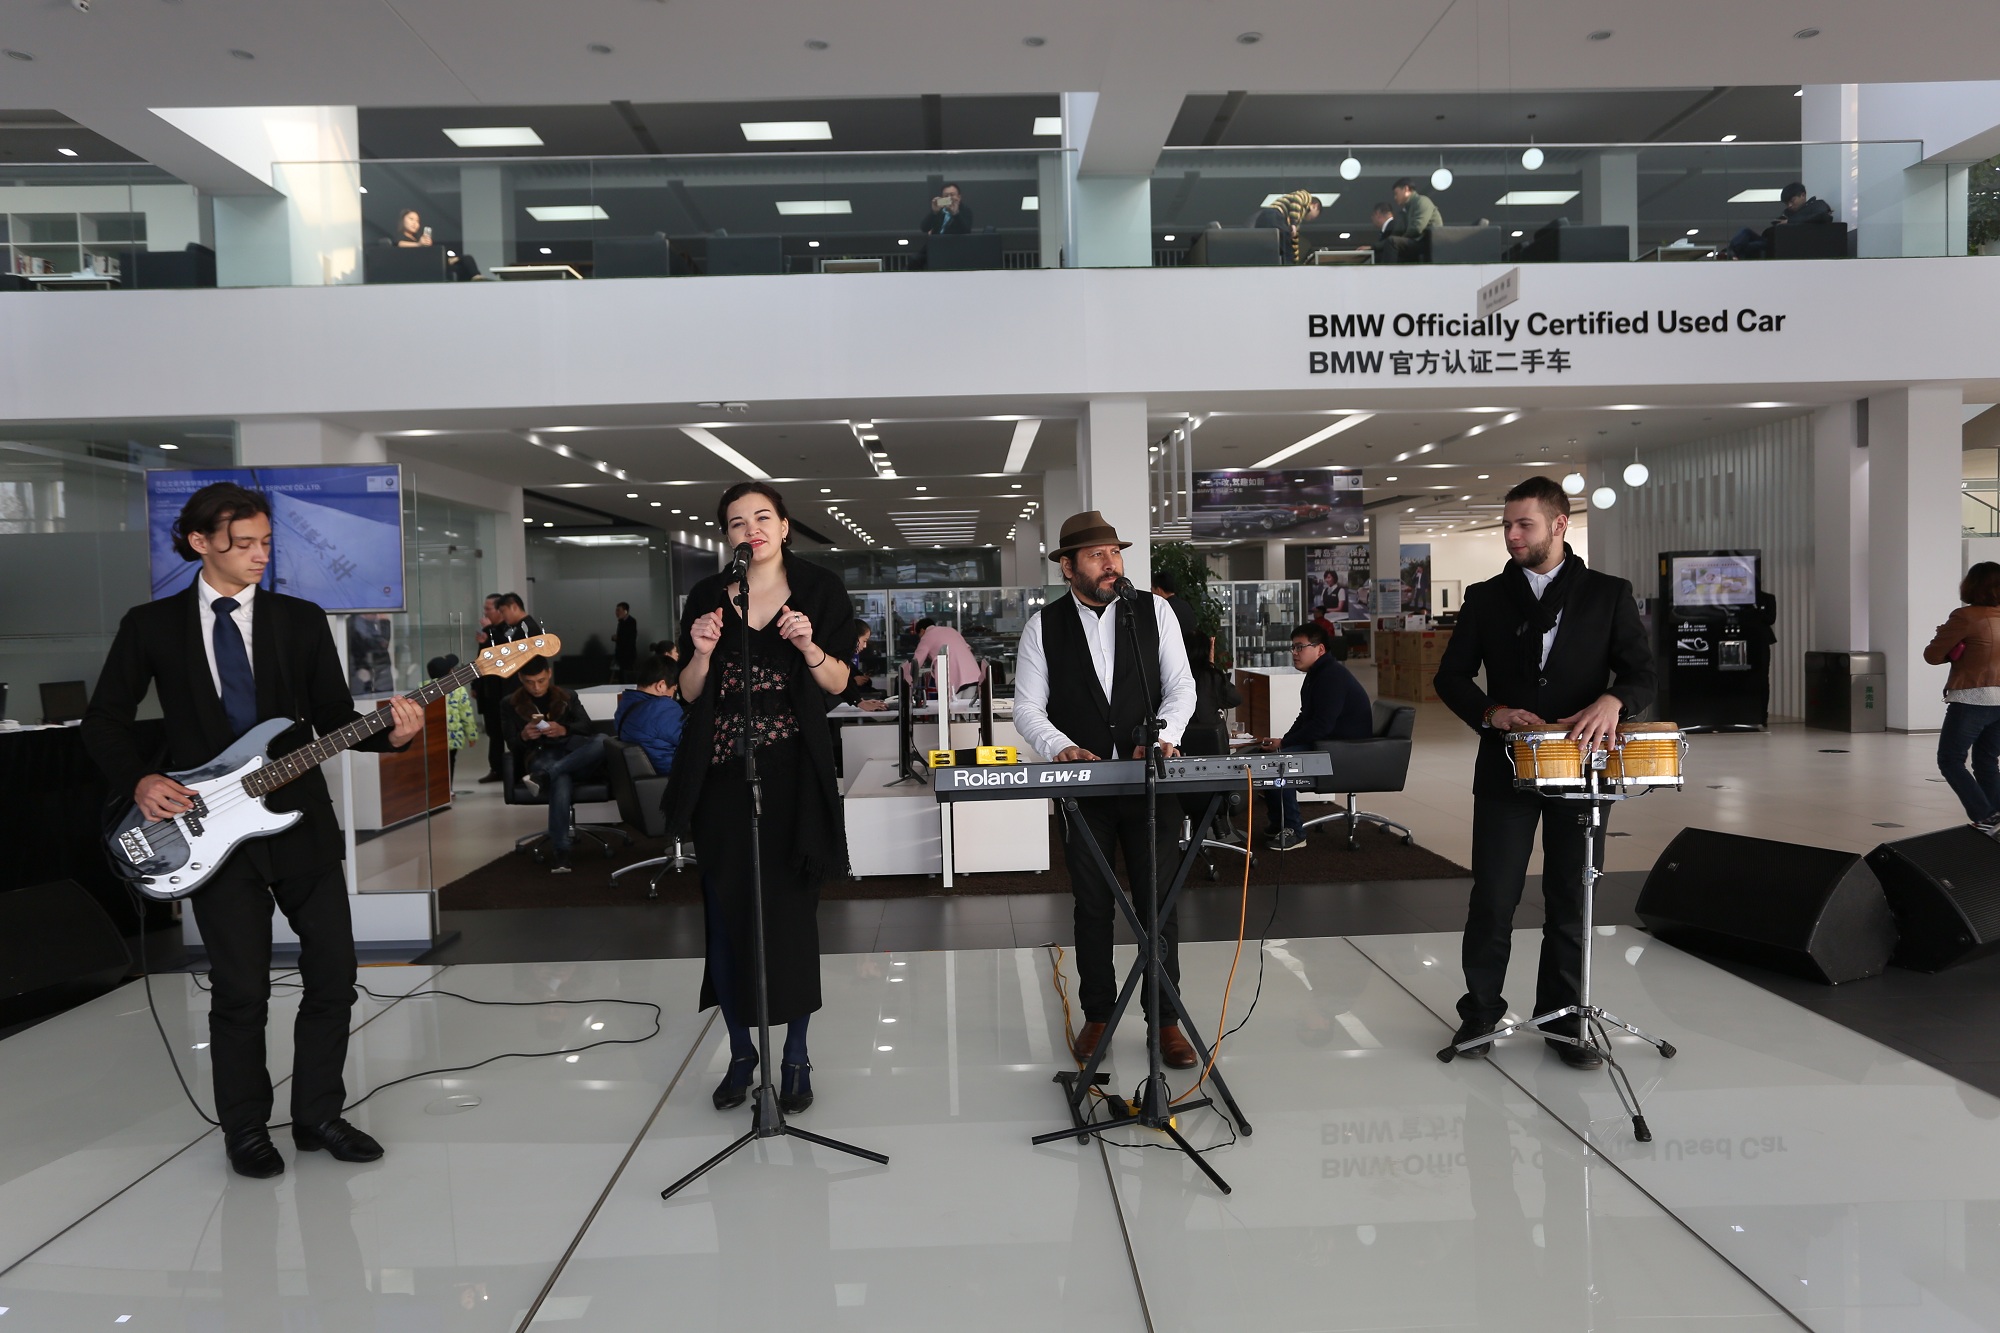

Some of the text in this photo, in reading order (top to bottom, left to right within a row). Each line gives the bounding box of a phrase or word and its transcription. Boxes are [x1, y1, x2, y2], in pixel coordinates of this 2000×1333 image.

[1308, 307, 1787, 342] BMW Officially Certified Used Car
[1309, 348, 1572, 376] BMW 官方认证二手车
[953, 767, 1092, 787] Roland GW-8
